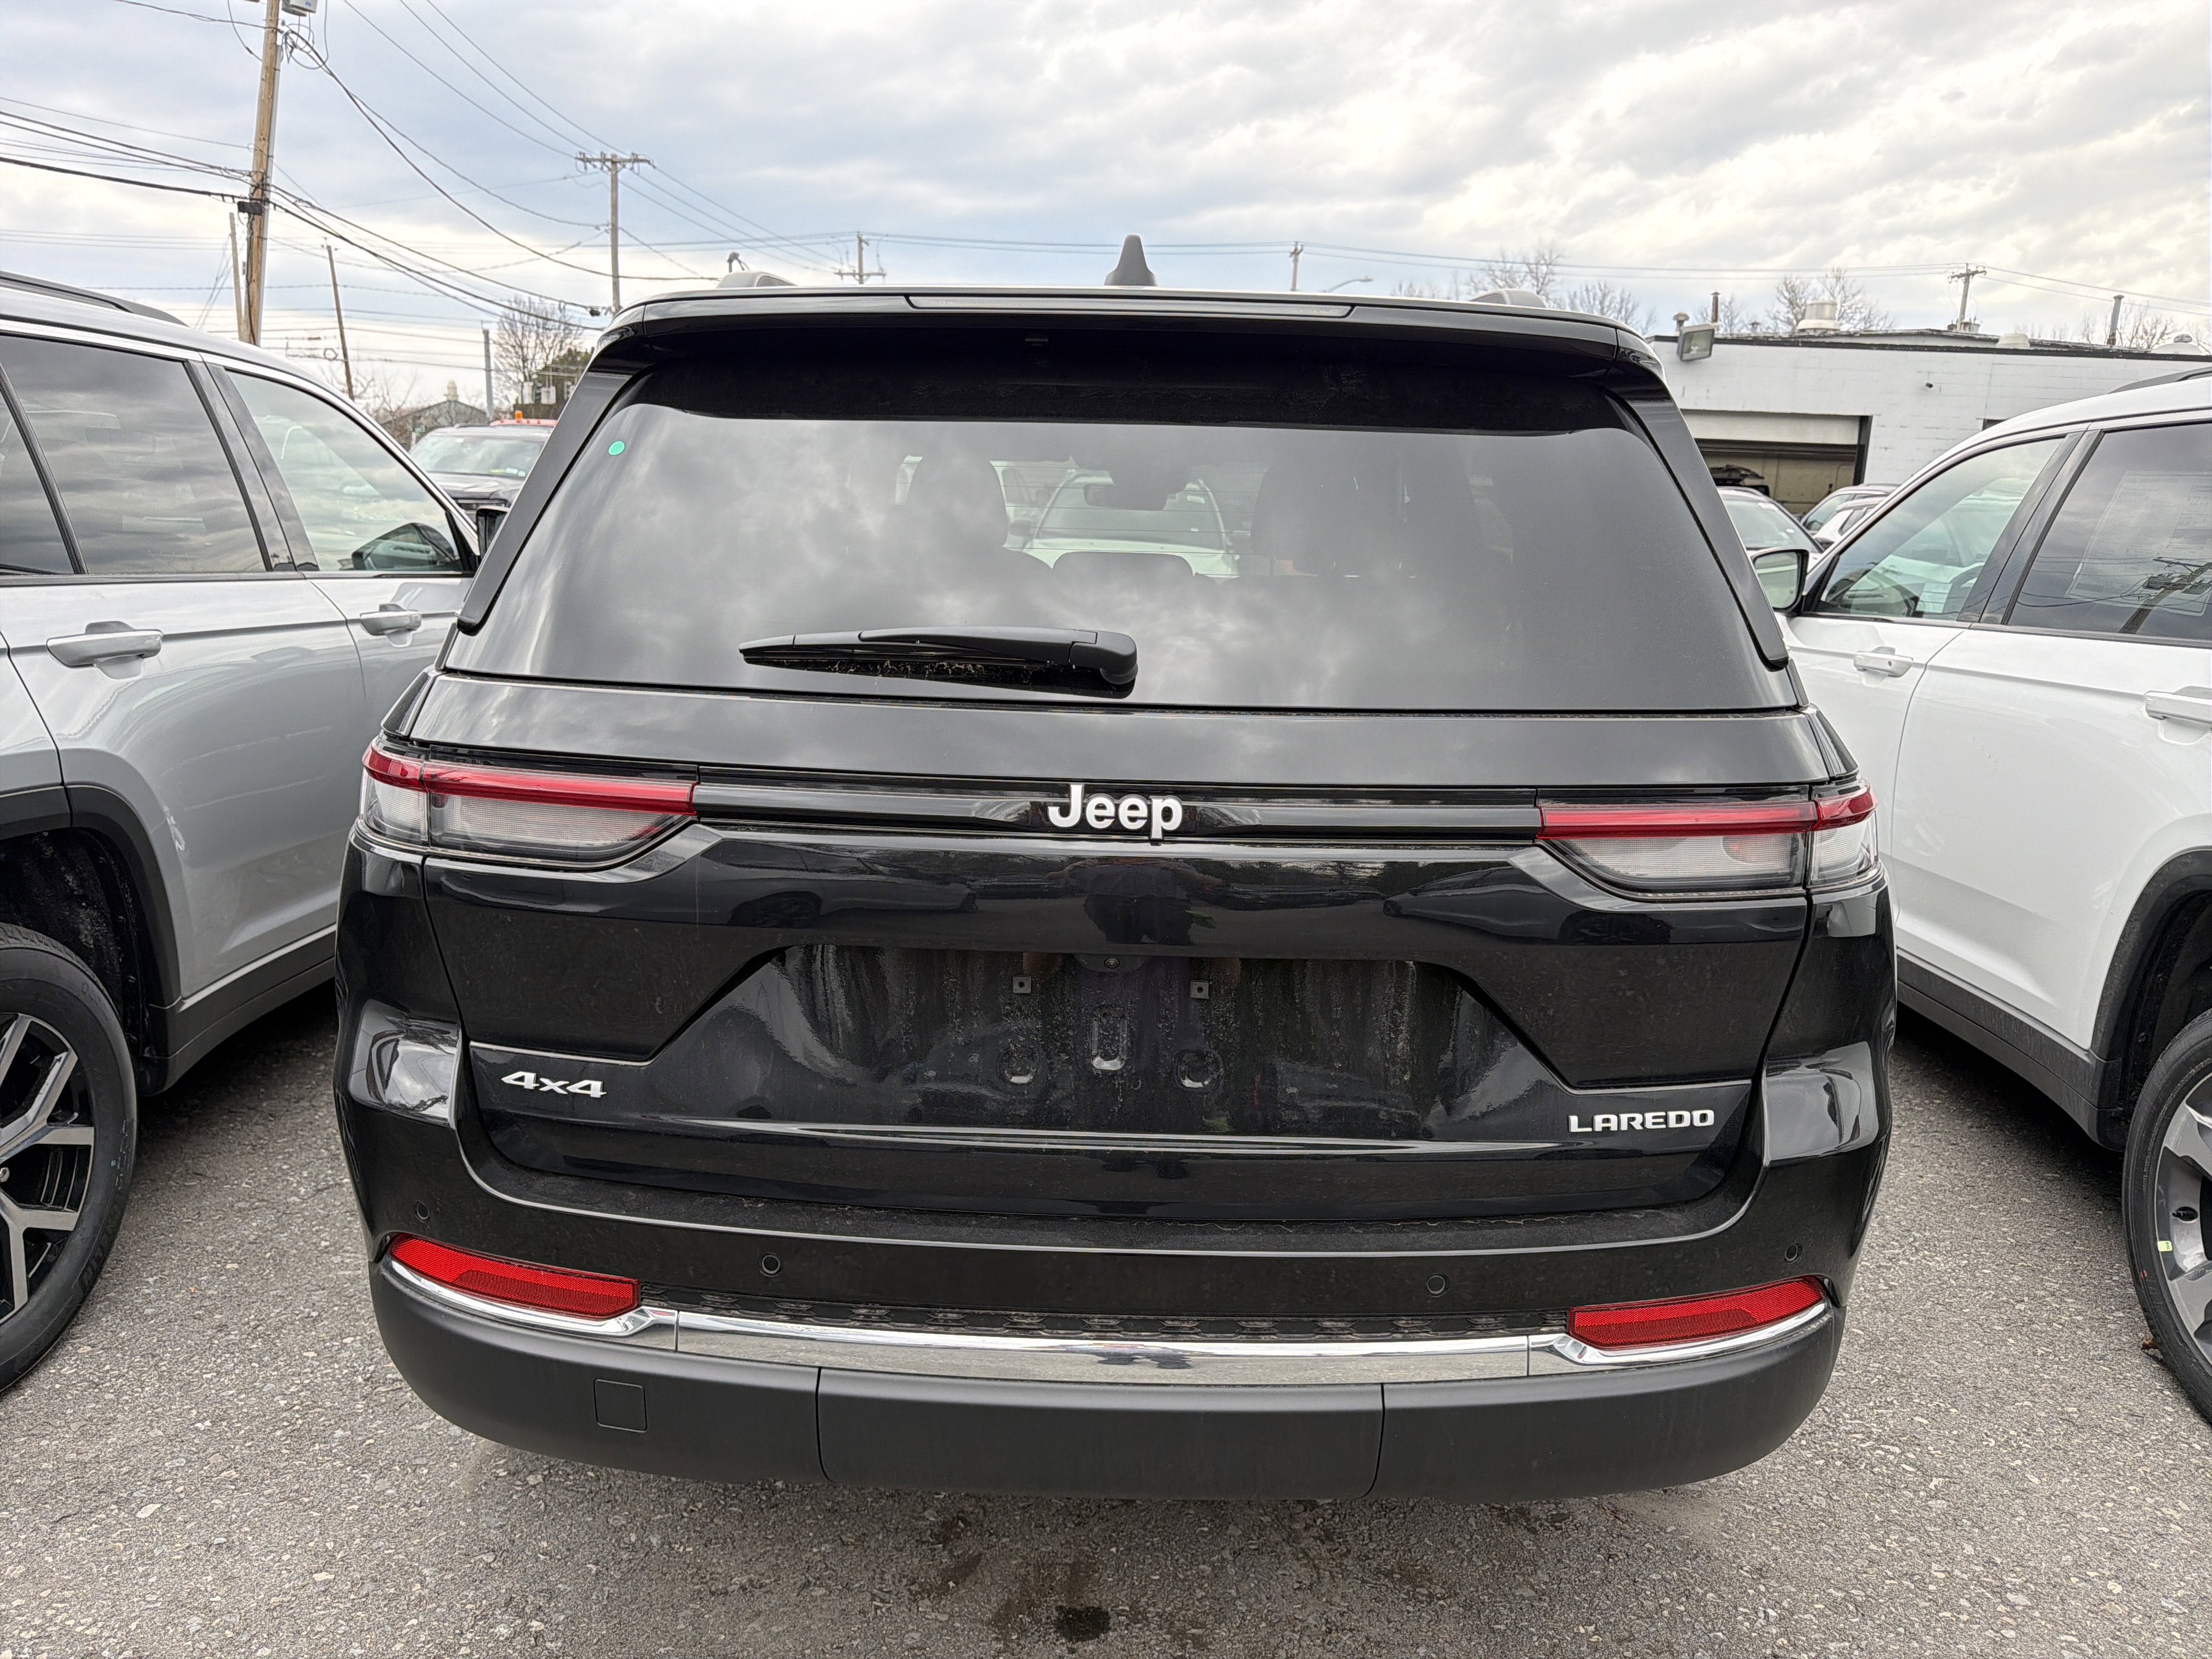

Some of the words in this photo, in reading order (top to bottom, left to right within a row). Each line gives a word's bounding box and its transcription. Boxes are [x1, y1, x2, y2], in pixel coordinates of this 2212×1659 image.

[1048, 784, 1183, 839] Jeep
[501, 1071, 607, 1098] 4x4
[1568, 1109, 1714, 1132] LAREDO
